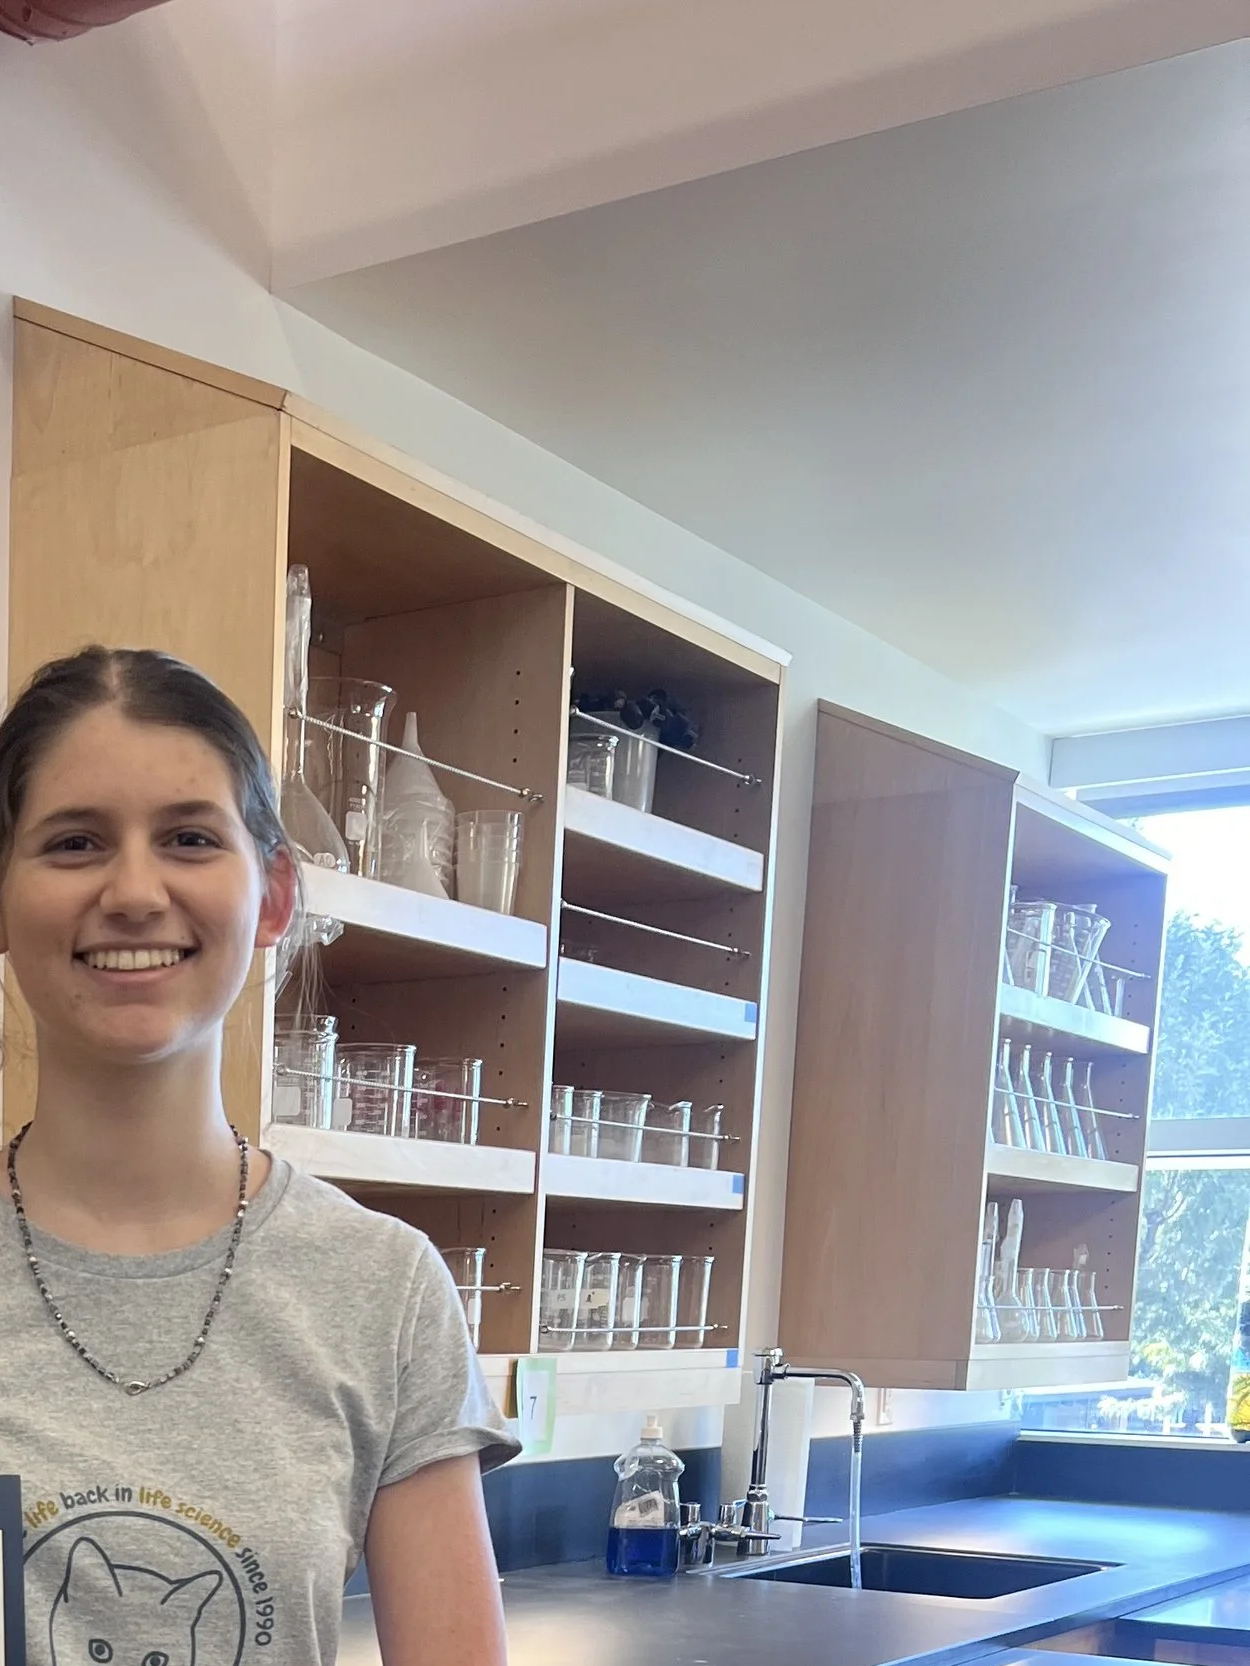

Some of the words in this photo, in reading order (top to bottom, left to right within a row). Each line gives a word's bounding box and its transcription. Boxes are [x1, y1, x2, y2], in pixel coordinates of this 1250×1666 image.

[530, 1396, 537, 1420] 7
[59, 1485, 109, 1510] back
[115, 1484, 133, 1502] in
[139, 1487, 172, 1509] life
[175, 1502, 242, 1548] science
[235, 1547, 269, 1594] since
[254, 1597, 274, 1647] 1990
